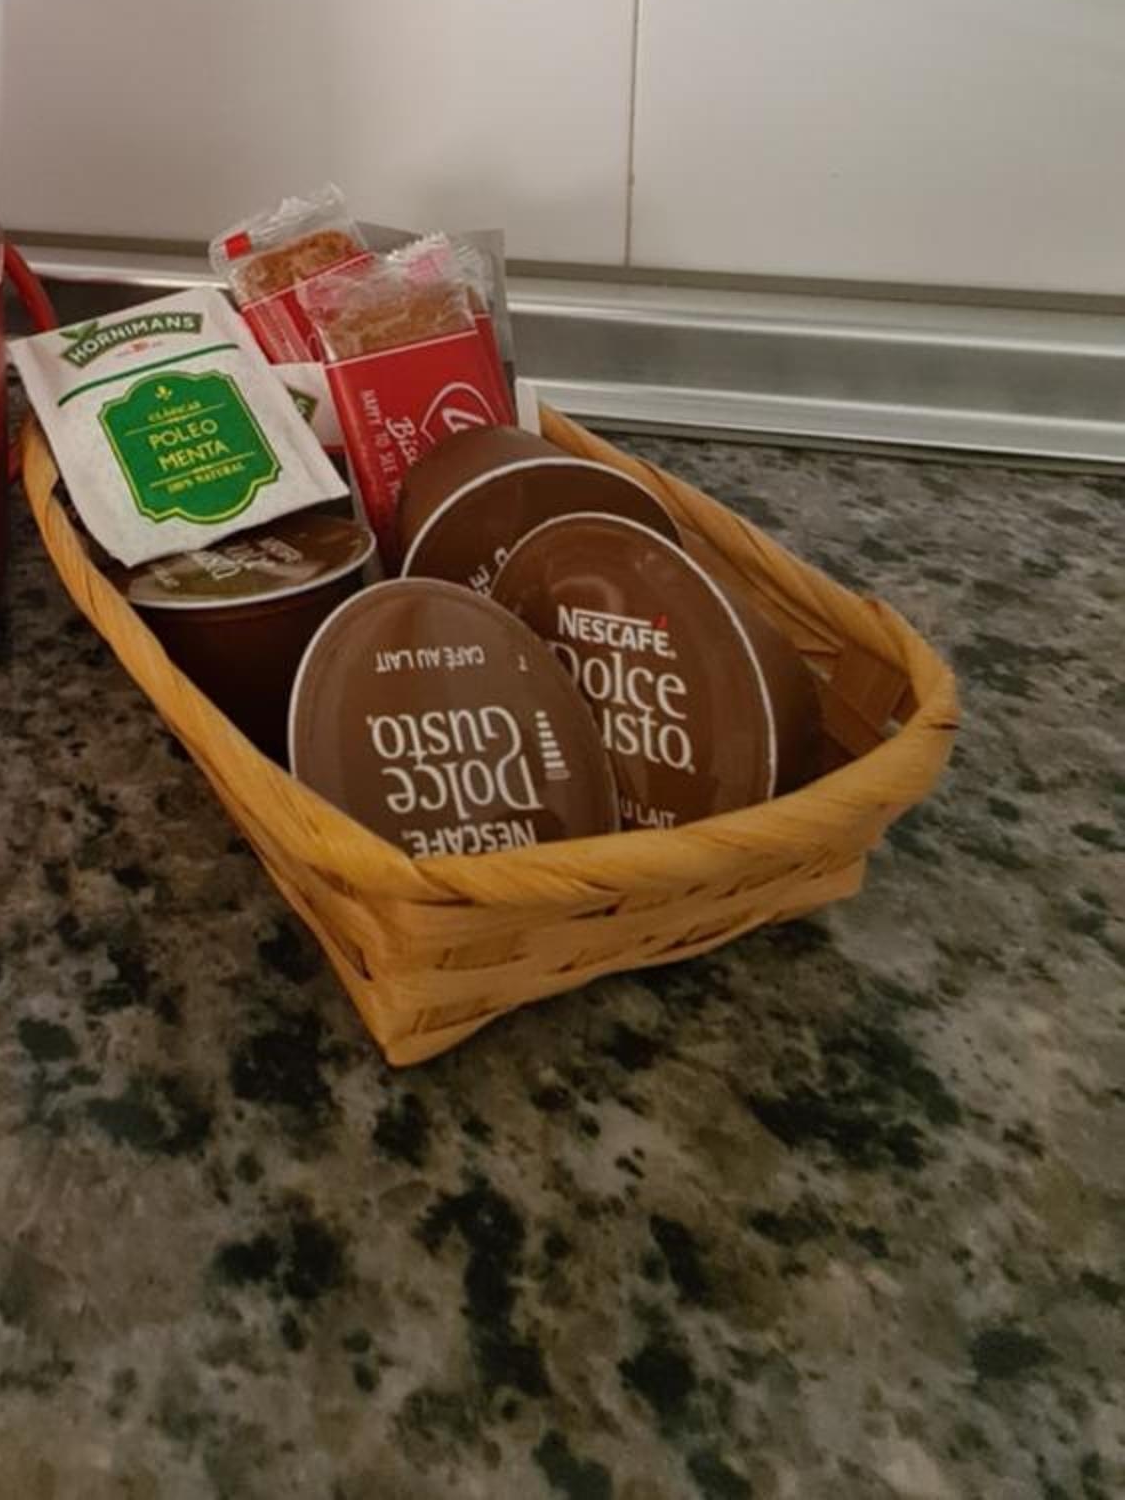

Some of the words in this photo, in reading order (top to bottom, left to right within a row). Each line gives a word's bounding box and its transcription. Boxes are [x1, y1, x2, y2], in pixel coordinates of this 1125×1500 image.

[68, 314, 196, 363] HORNIMANS
[148, 418, 219, 450] POLEO
[158, 439, 231, 472] MENTA
[375, 649, 415, 673] LAIT
[416, 647, 441, 669] AU
[443, 644, 485, 671] CAFÉ
[371, 705, 522, 764] Gusto
[381, 754, 544, 821] Dolce
